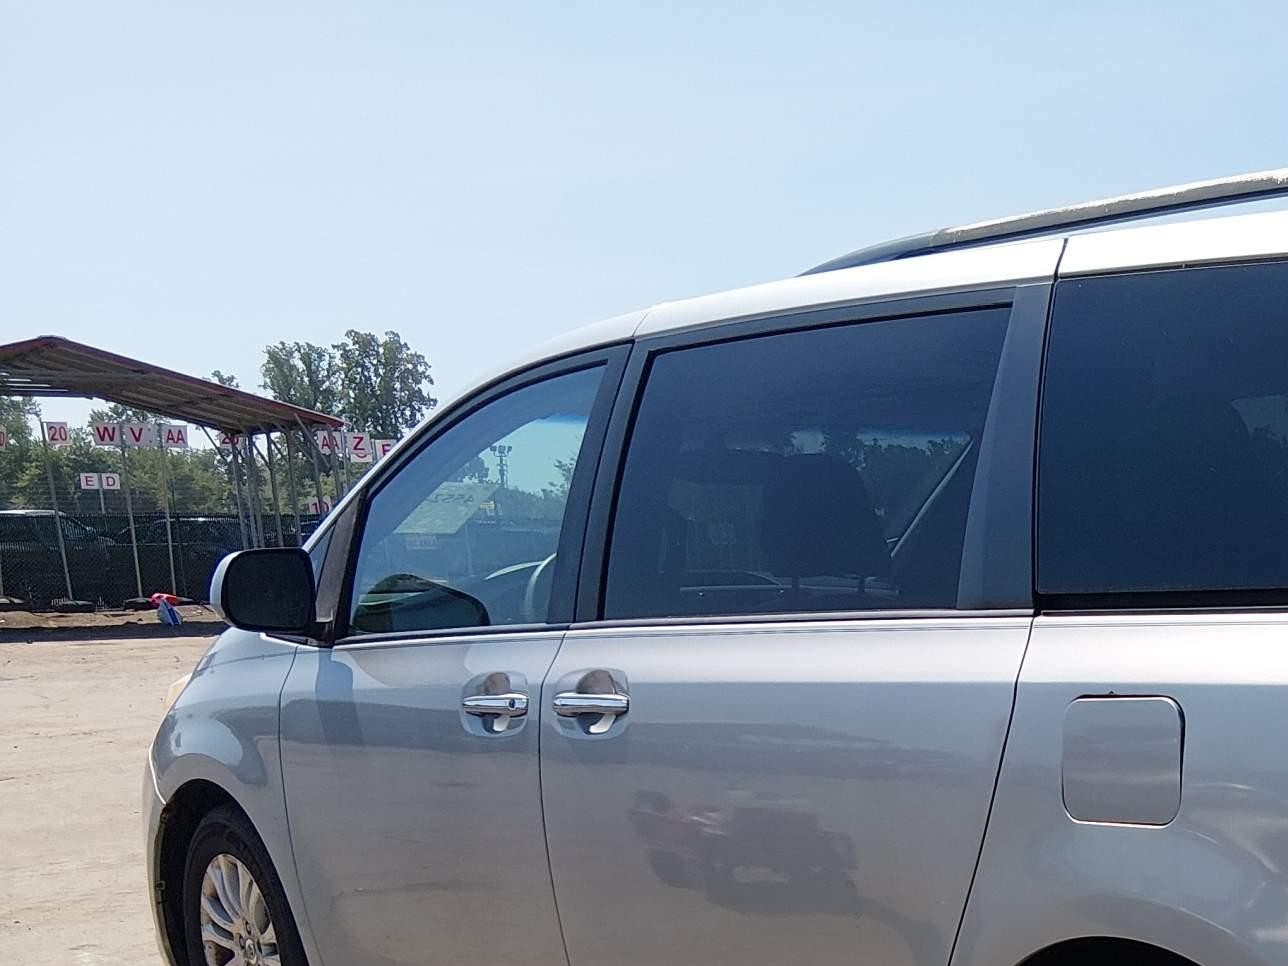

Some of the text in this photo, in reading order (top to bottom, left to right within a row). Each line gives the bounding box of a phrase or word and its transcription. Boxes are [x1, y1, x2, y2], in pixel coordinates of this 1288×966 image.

[49, 425, 68, 441] 20
[95, 426, 116, 442] W
[129, 427, 144, 443] V
[166, 429, 186, 444] AA
[352, 436, 365, 451] Z
[85, 475, 94, 487] E
[106, 476, 116, 487] D
